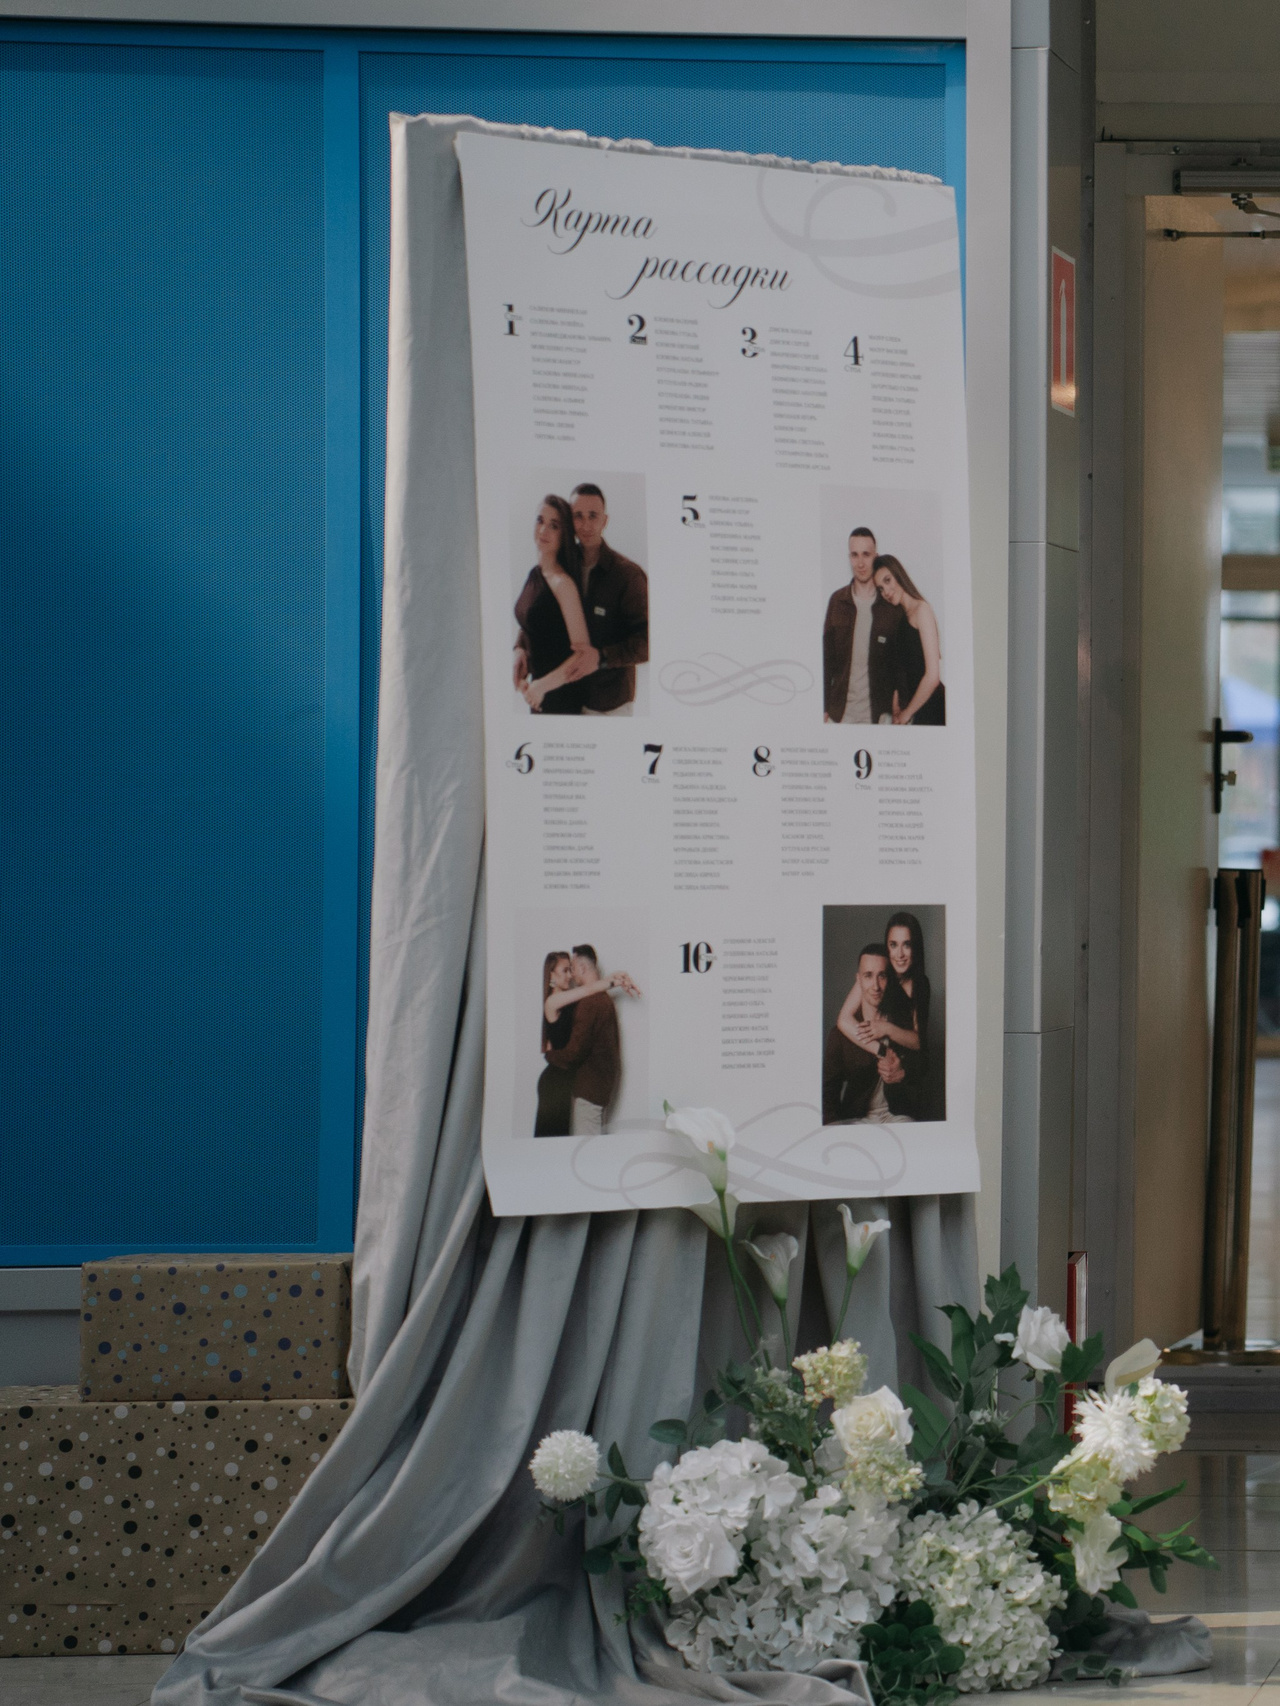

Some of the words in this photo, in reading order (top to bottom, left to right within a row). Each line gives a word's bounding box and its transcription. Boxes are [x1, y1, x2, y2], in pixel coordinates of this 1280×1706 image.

[521, 188, 656, 255] Карта
[605, 254, 792, 309] рассадки
[502, 303, 520, 337] 1
[627, 313, 648, 346] 2
[741, 326, 759, 358] 3
[843, 335, 864, 366] 4
[681, 493, 701, 526] 5
[514, 741, 535, 774] 6
[643, 743, 664, 776] 7
[752, 745, 771, 778] 8
[853, 748, 873, 780] 9
[679, 941, 713, 974] 10
